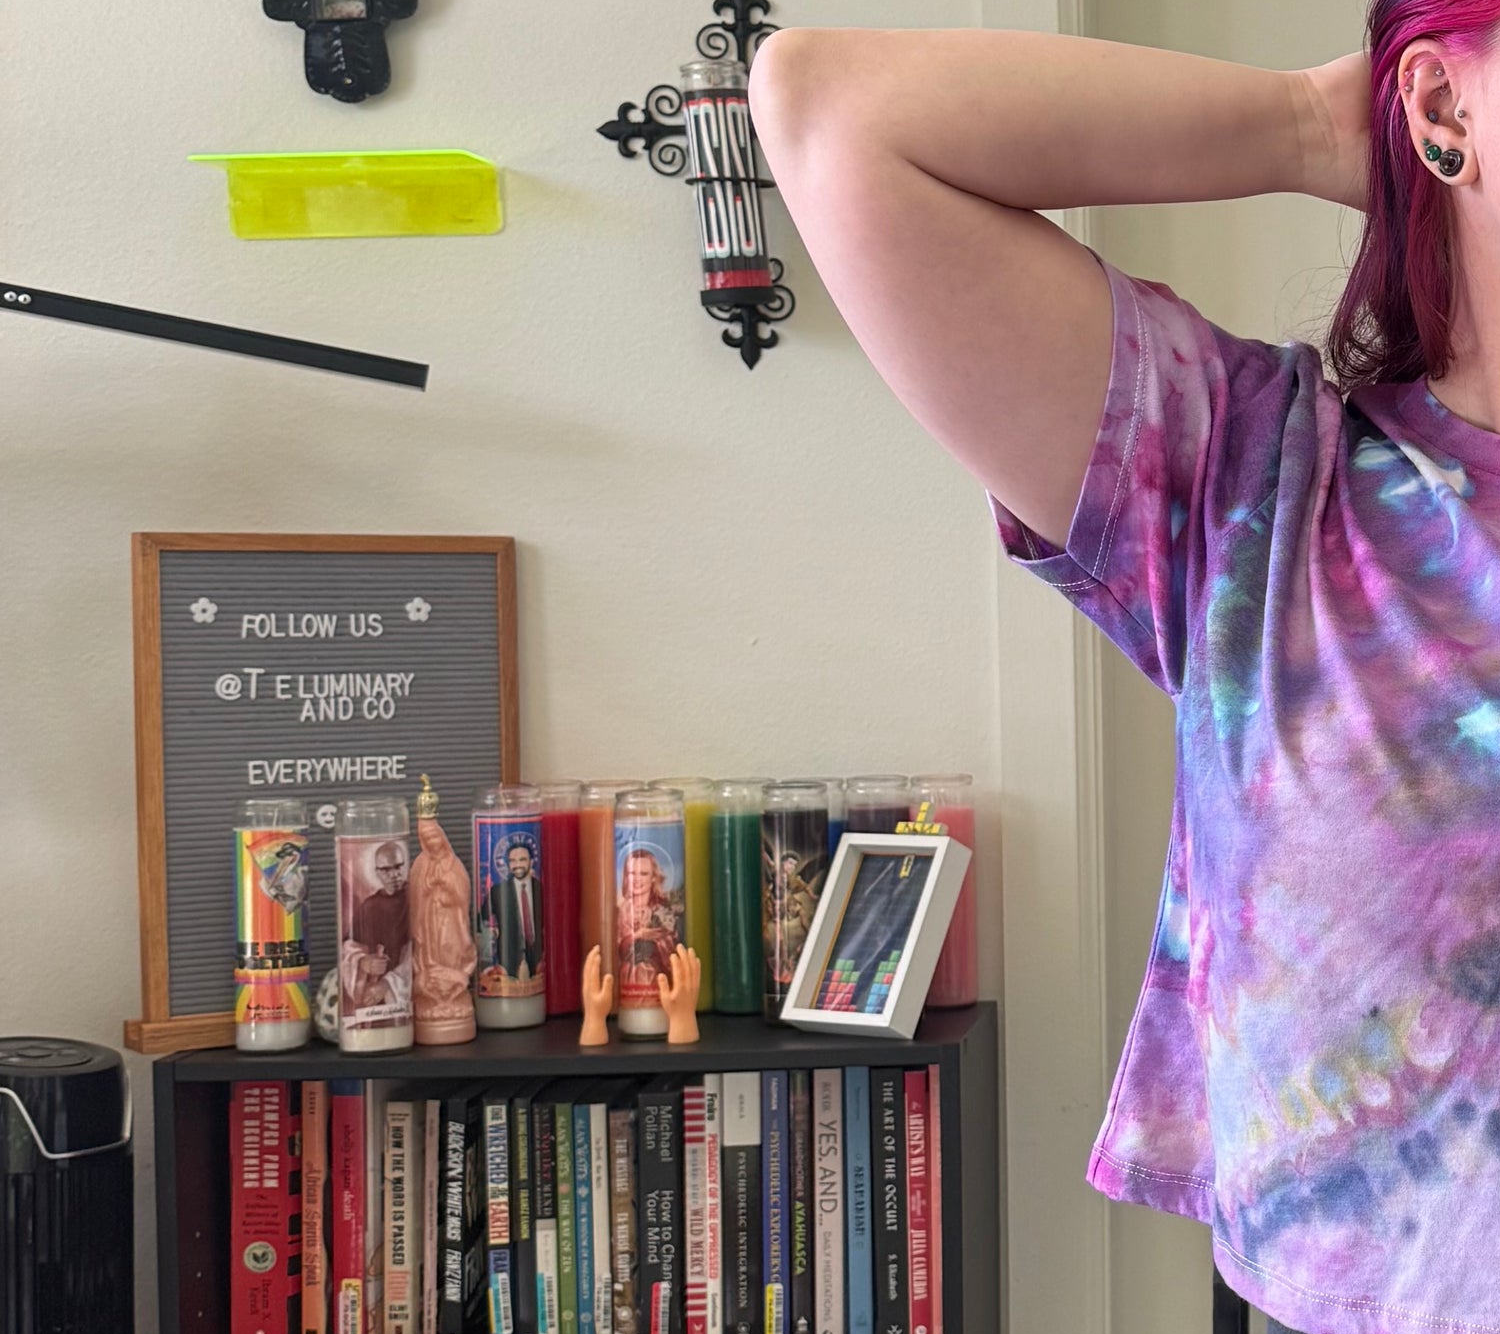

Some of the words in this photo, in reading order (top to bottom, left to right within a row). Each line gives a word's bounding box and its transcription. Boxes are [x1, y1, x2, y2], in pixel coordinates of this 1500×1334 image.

[242, 613, 337, 638] FOLLOW
[350, 613, 383, 637] US
[299, 673, 415, 700] LUMINARY
[300, 696, 353, 722] AND
[363, 696, 395, 720] CO
[248, 755, 407, 785] EVERYWHERE
[243, 1087, 260, 1113] THE
[882, 1082, 894, 1102] THE
[263, 1087, 279, 1147] STAMPED
[645, 1106, 659, 1150] Pollan
[883, 1108, 895, 1130] ART
[391, 1125, 405, 1150] HOW
[660, 1105, 675, 1162] Michael
[884, 1135, 896, 1152] OF
[243, 1119, 260, 1188] BEGINNING
[391, 1153, 405, 1173] THE
[488, 1122, 508, 1184] WRETCHED
[263, 1153, 279, 1188] FROM
[884, 1158, 897, 1179] THE
[341, 1190, 355, 1221] death
[392, 1177, 406, 1208] WORD
[542, 1183, 553, 1216] MIND
[561, 1199, 571, 1216] THE
[647, 1190, 661, 1222] Your
[660, 1190, 675, 1222] How
[392, 1210, 406, 1223] IS
[489, 1201, 510, 1241] EARTH
[690, 1209, 704, 1236] WILD
[884, 1184, 898, 1232] OCCULT
[392, 1225, 406, 1267] PASSED
[562, 1240, 572, 1253] OF
[647, 1227, 661, 1264] Mind
[660, 1226, 674, 1240] to
[794, 1200, 807, 1276] AYAHUASCA
[562, 1255, 573, 1273] ZEN
[738, 1231, 748, 1309] INTEGRATION
